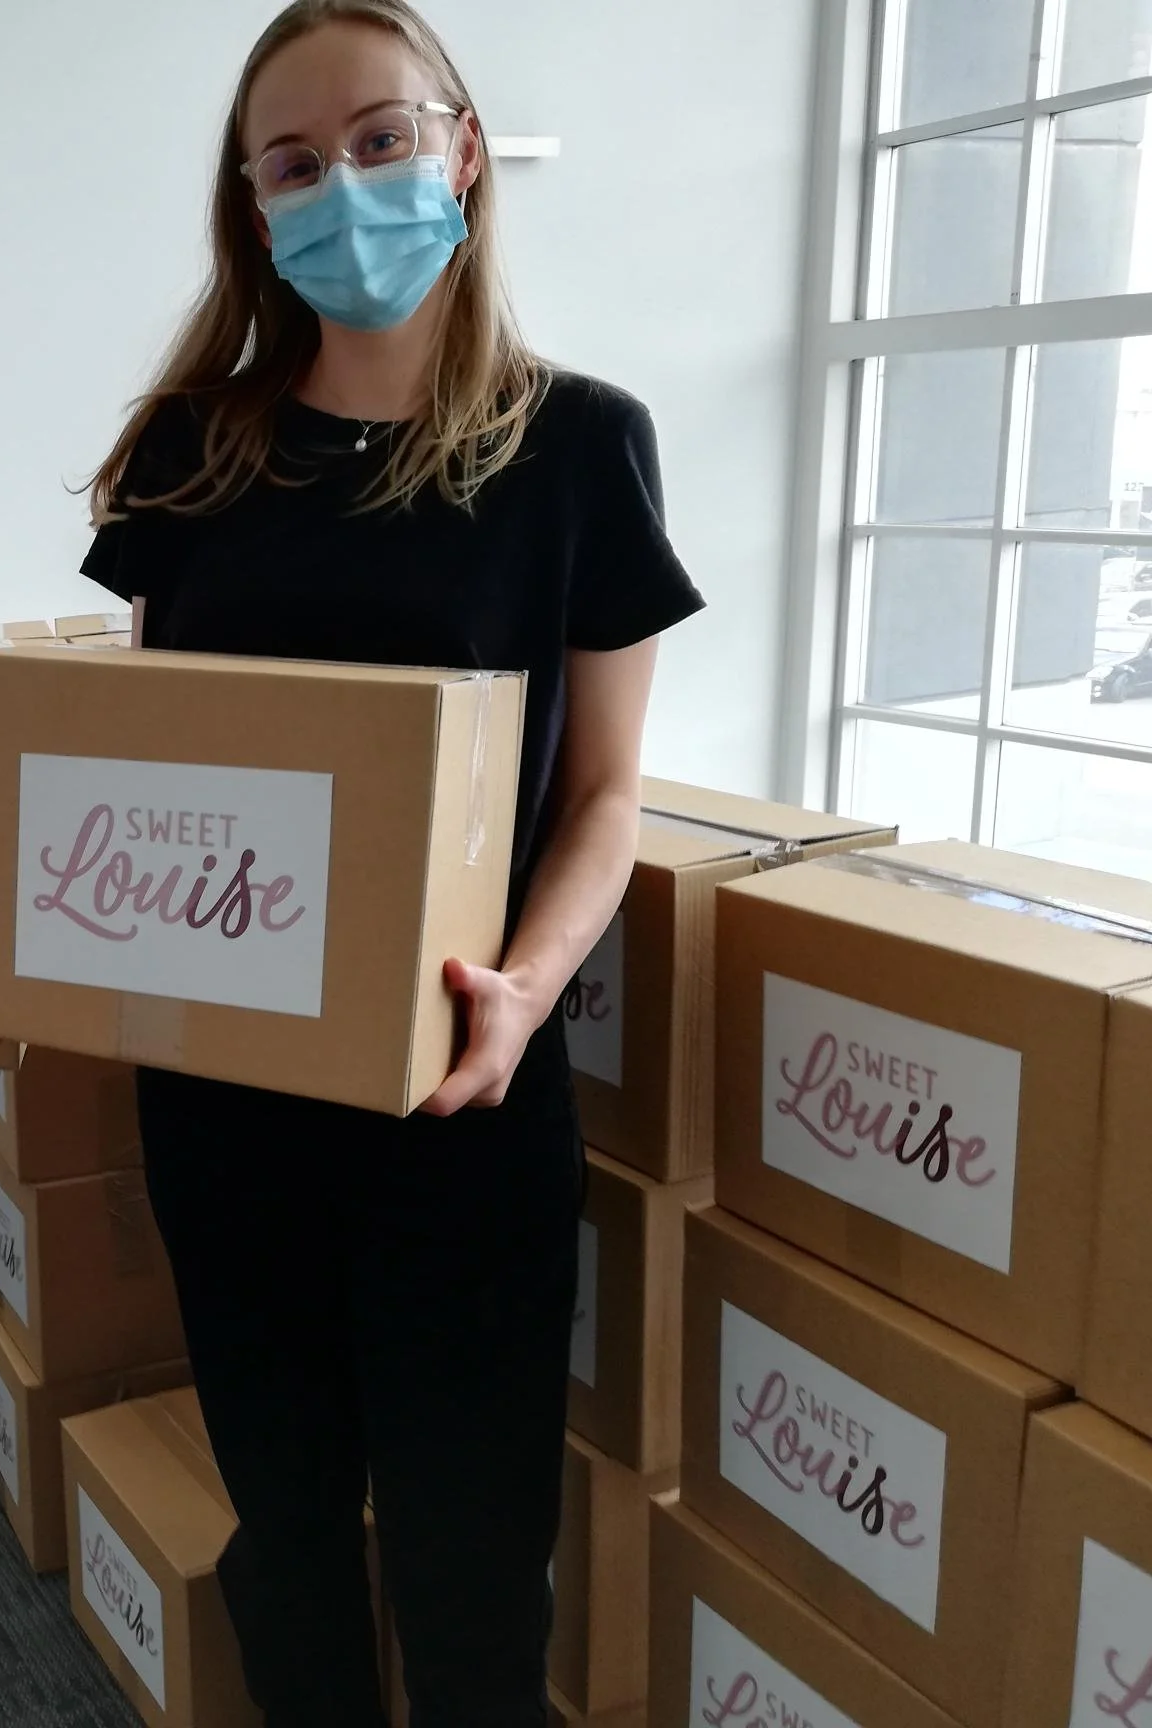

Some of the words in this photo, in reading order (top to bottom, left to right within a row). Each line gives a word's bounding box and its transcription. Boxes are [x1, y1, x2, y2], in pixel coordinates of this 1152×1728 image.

[33, 803, 306, 942] Louise
[126, 807, 238, 849] SWEET
[776, 1032, 996, 1186] Louise
[848, 1042, 938, 1100] SWEET
[732, 1369, 925, 1547] Louise
[796, 1386, 874, 1457] SWEET
[86, 1533, 159, 1657] Louise
